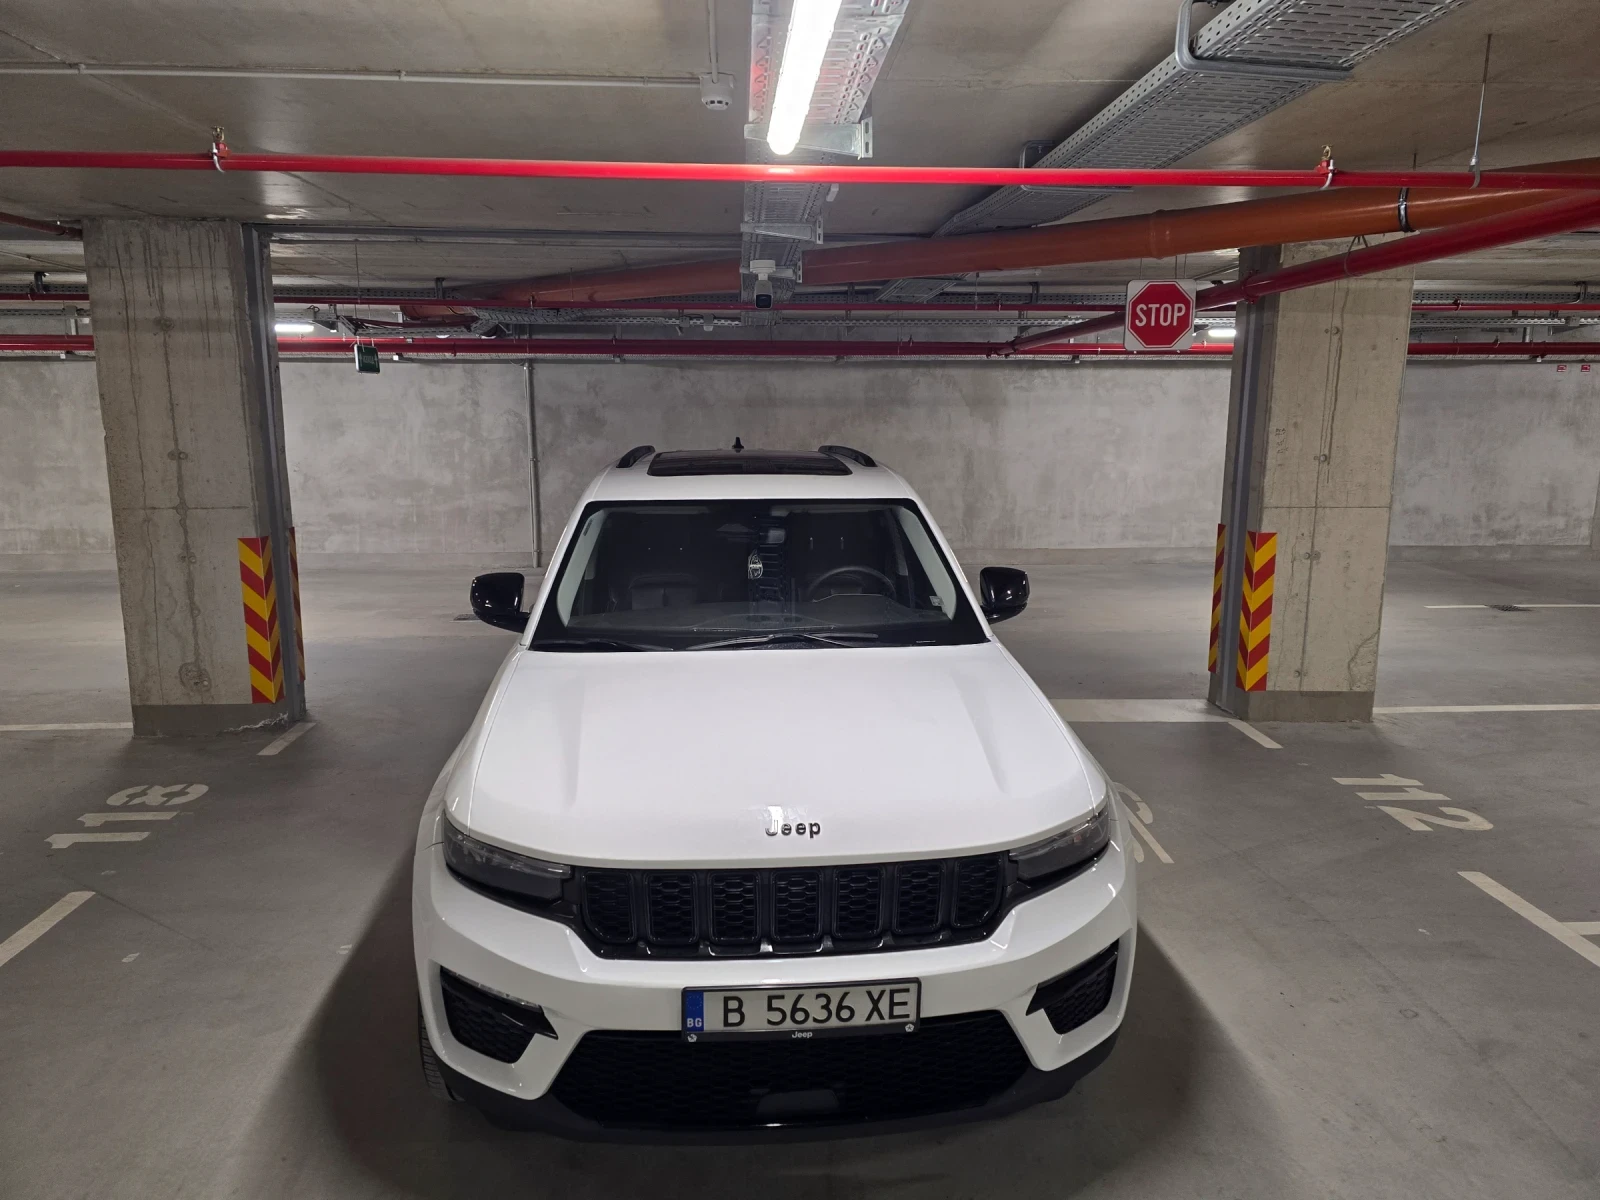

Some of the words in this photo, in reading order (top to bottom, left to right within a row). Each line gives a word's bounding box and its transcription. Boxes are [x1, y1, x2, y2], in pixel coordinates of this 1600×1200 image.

[1135, 303, 1186, 327] STOP
[1331, 773, 1494, 831] 112
[44, 783, 209, 849] 118
[765, 816, 820, 839] Jeep
[723, 996, 745, 1027] B
[766, 992, 855, 1026] 5636
[865, 988, 910, 1021] XE
[686, 1018, 702, 1028] BG
[791, 1031, 813, 1039] Jeep
